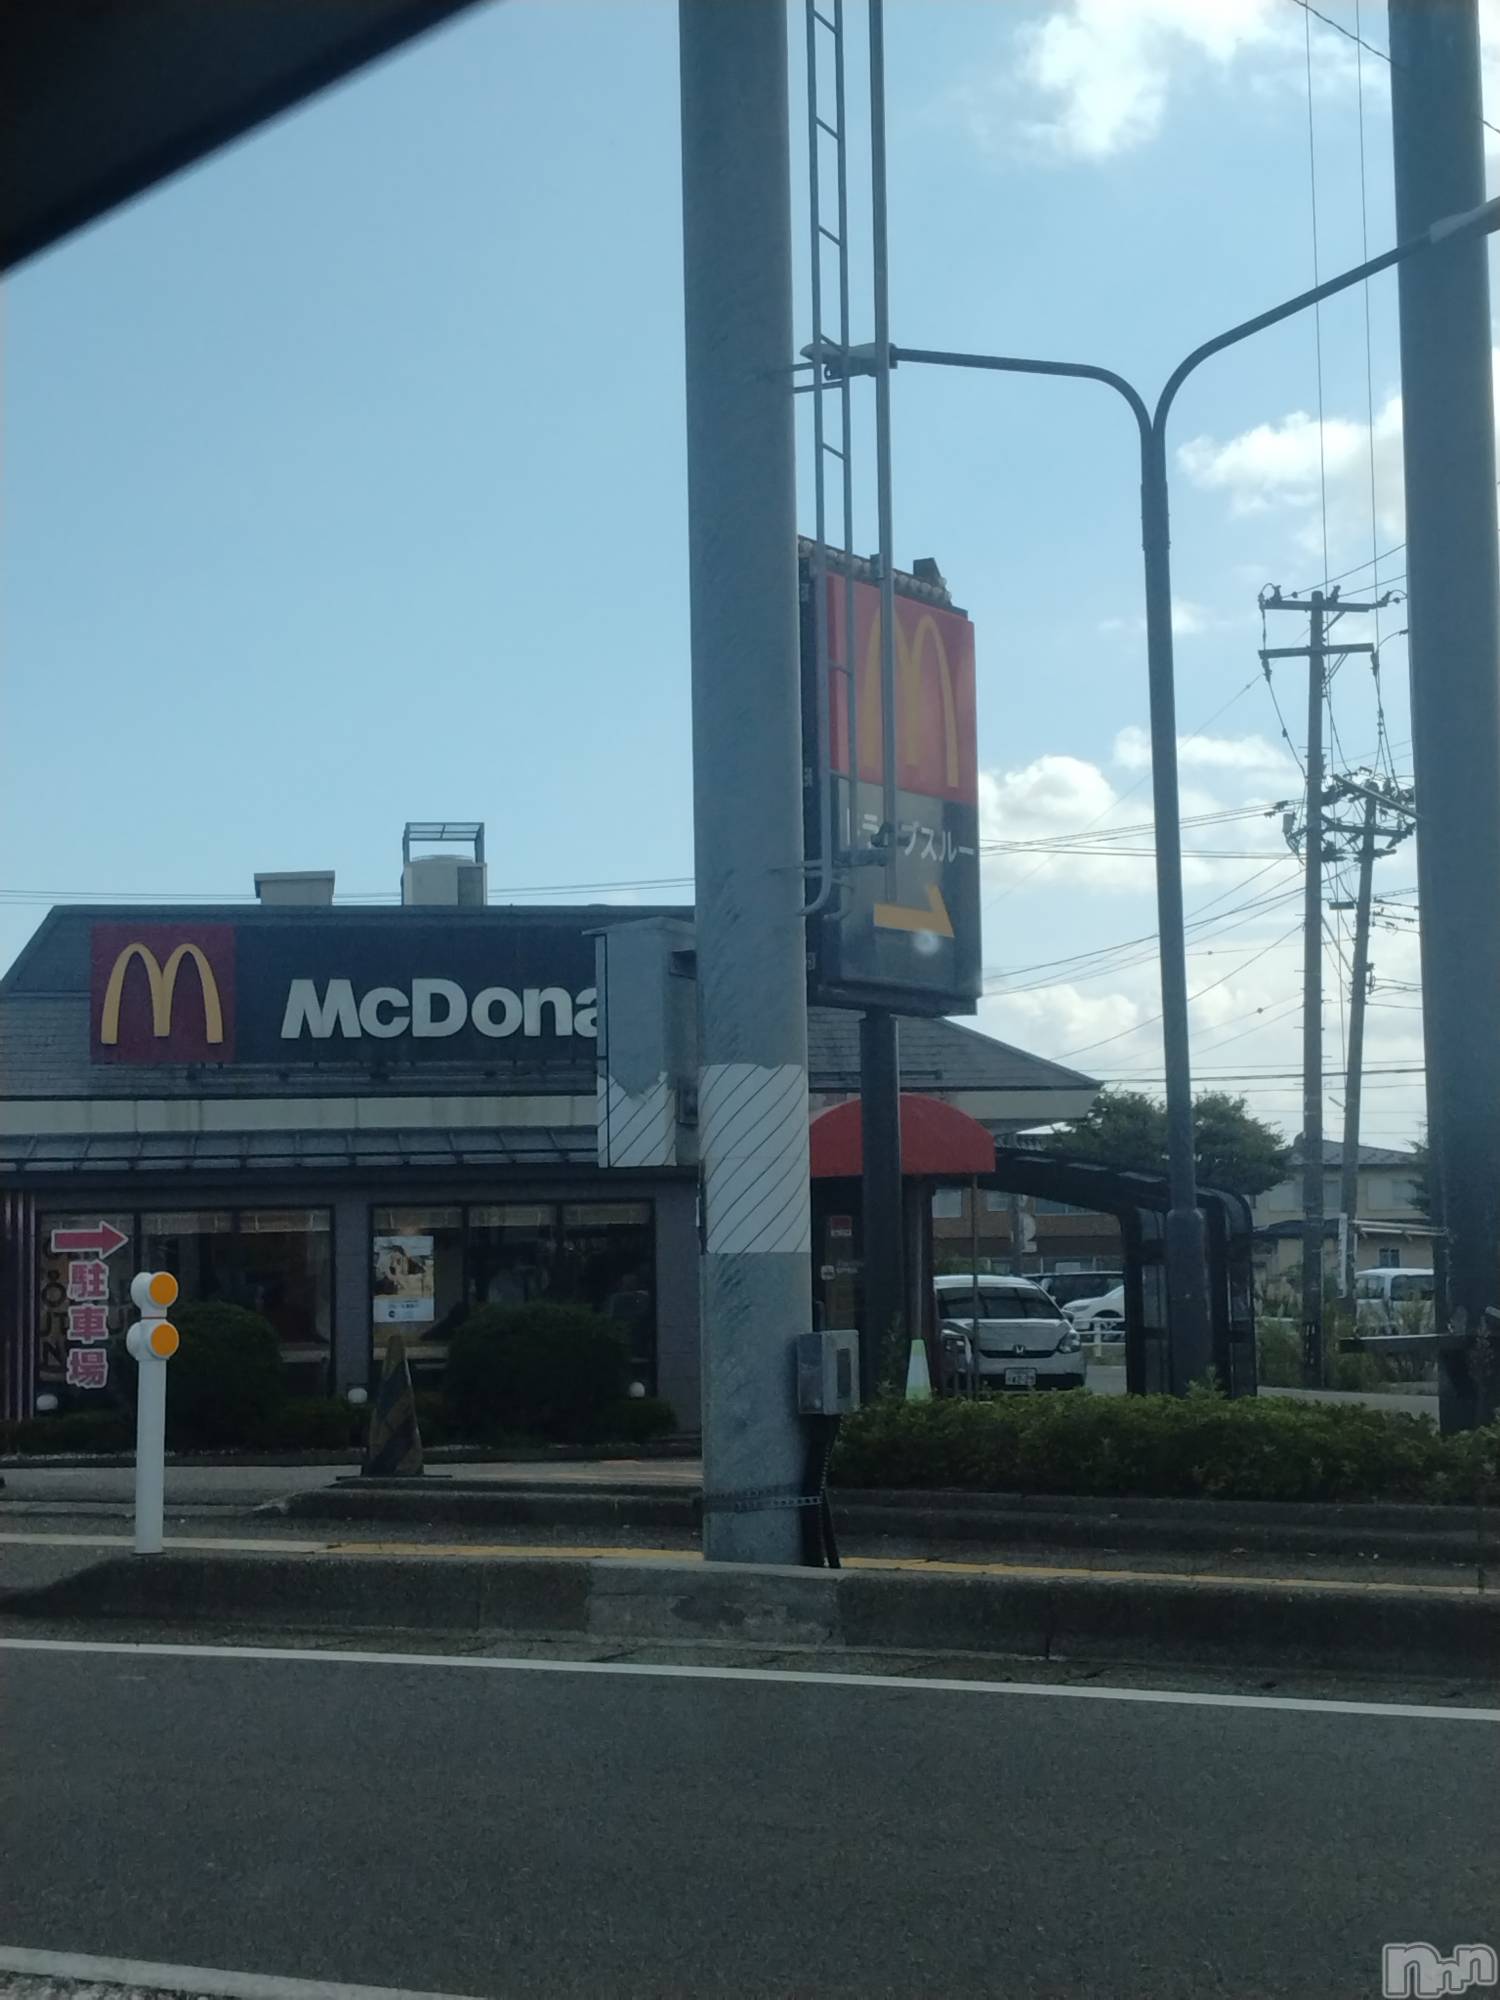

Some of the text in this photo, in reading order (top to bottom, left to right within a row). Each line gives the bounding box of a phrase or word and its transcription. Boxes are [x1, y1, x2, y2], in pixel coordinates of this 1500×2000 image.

[846, 807, 975, 863] ラブスルー
[66, 1259, 109, 1389] 駐車場
